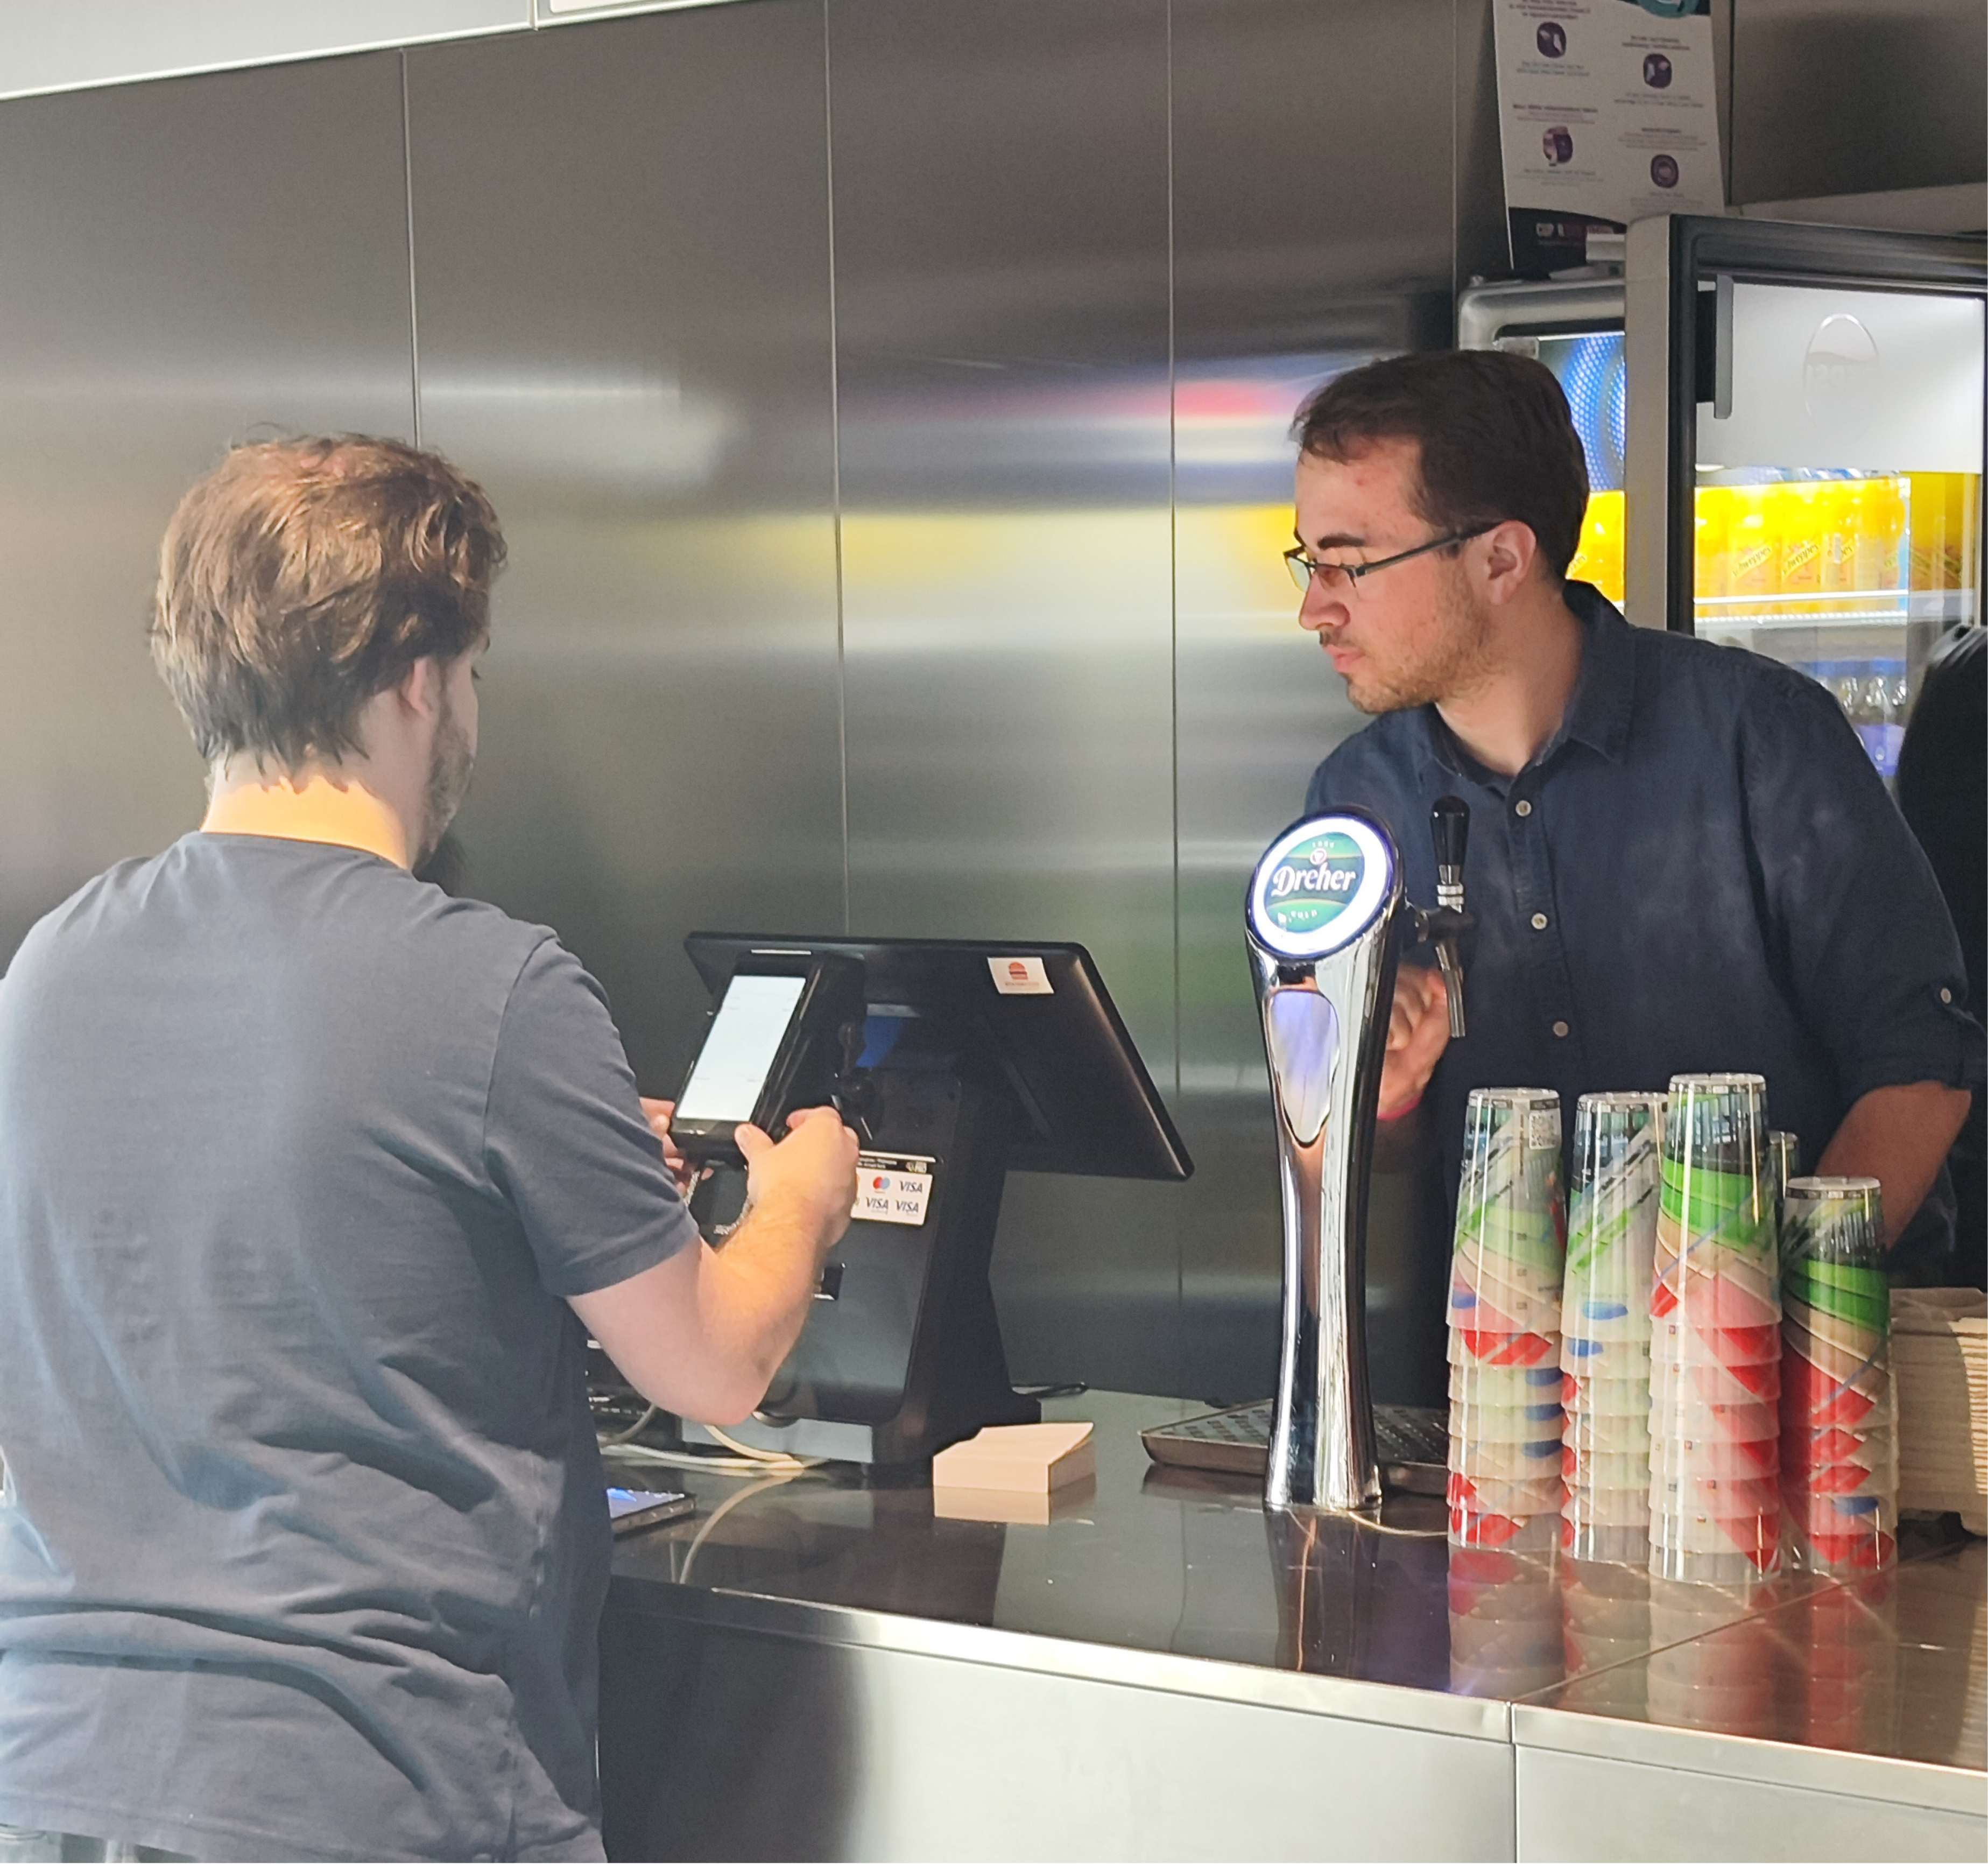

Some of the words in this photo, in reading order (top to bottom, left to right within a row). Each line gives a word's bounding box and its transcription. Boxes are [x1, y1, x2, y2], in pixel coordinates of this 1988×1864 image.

[1271, 862, 1357, 897] Dreher
[899, 1180, 922, 1194] VISA
[865, 1196, 889, 1209] VISA
[895, 1199, 919, 1213] VISA
